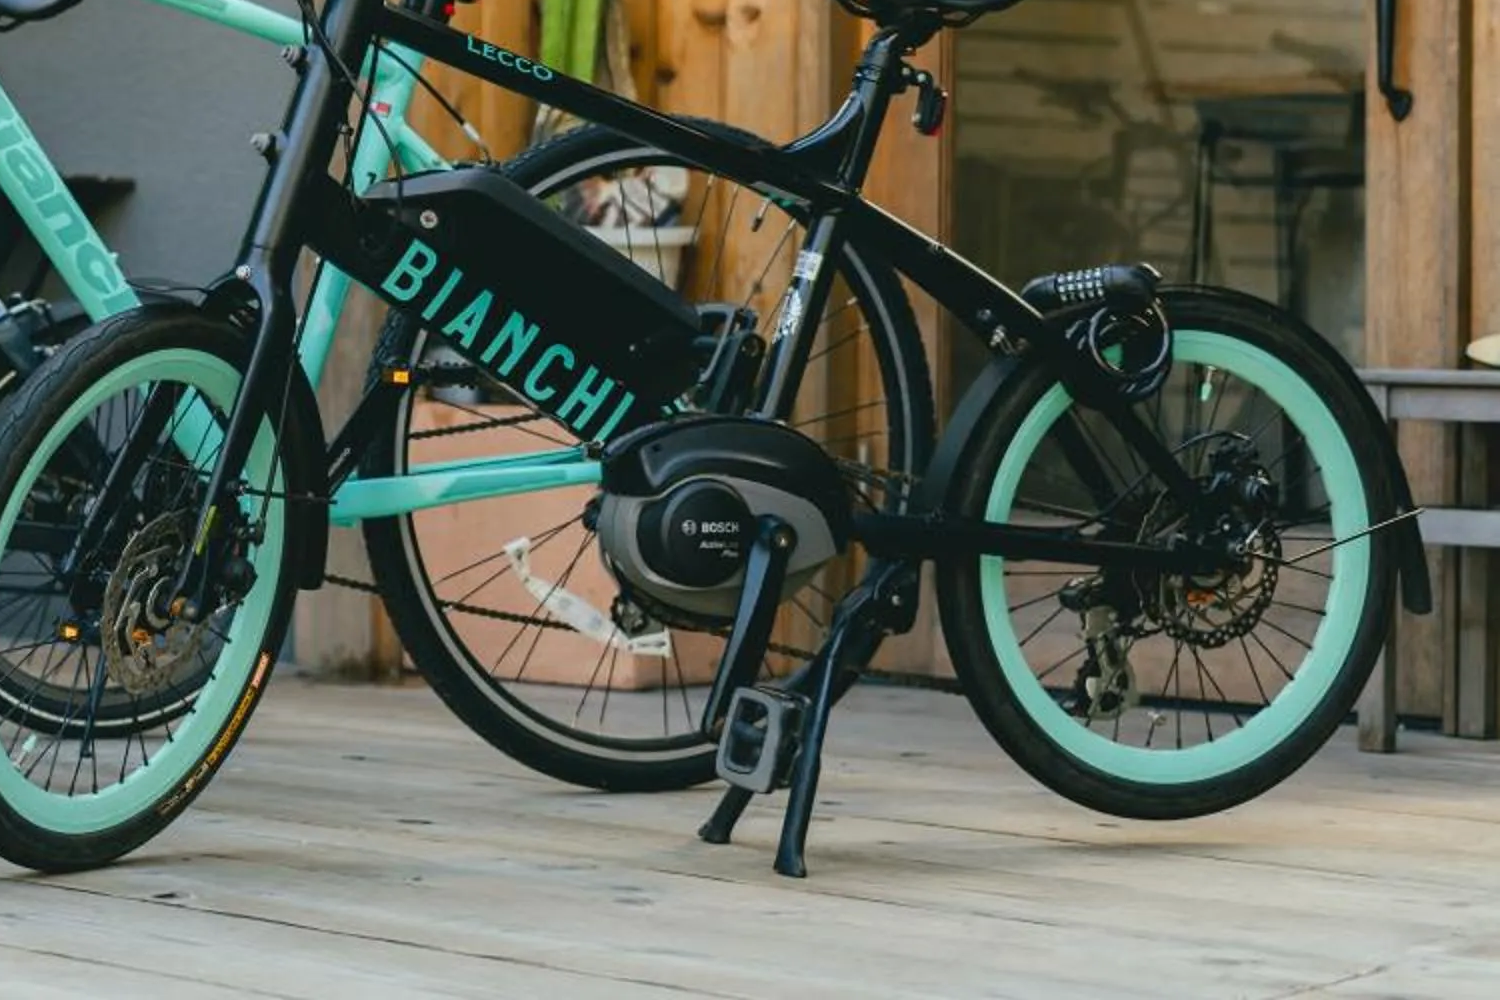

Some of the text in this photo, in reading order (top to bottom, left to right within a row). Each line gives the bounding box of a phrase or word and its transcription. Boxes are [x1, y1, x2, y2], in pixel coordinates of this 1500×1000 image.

[466, 33, 553, 81] LECCO
[380, 238, 636, 443] BIANCHI
[701, 521, 740, 534] BOSCH
